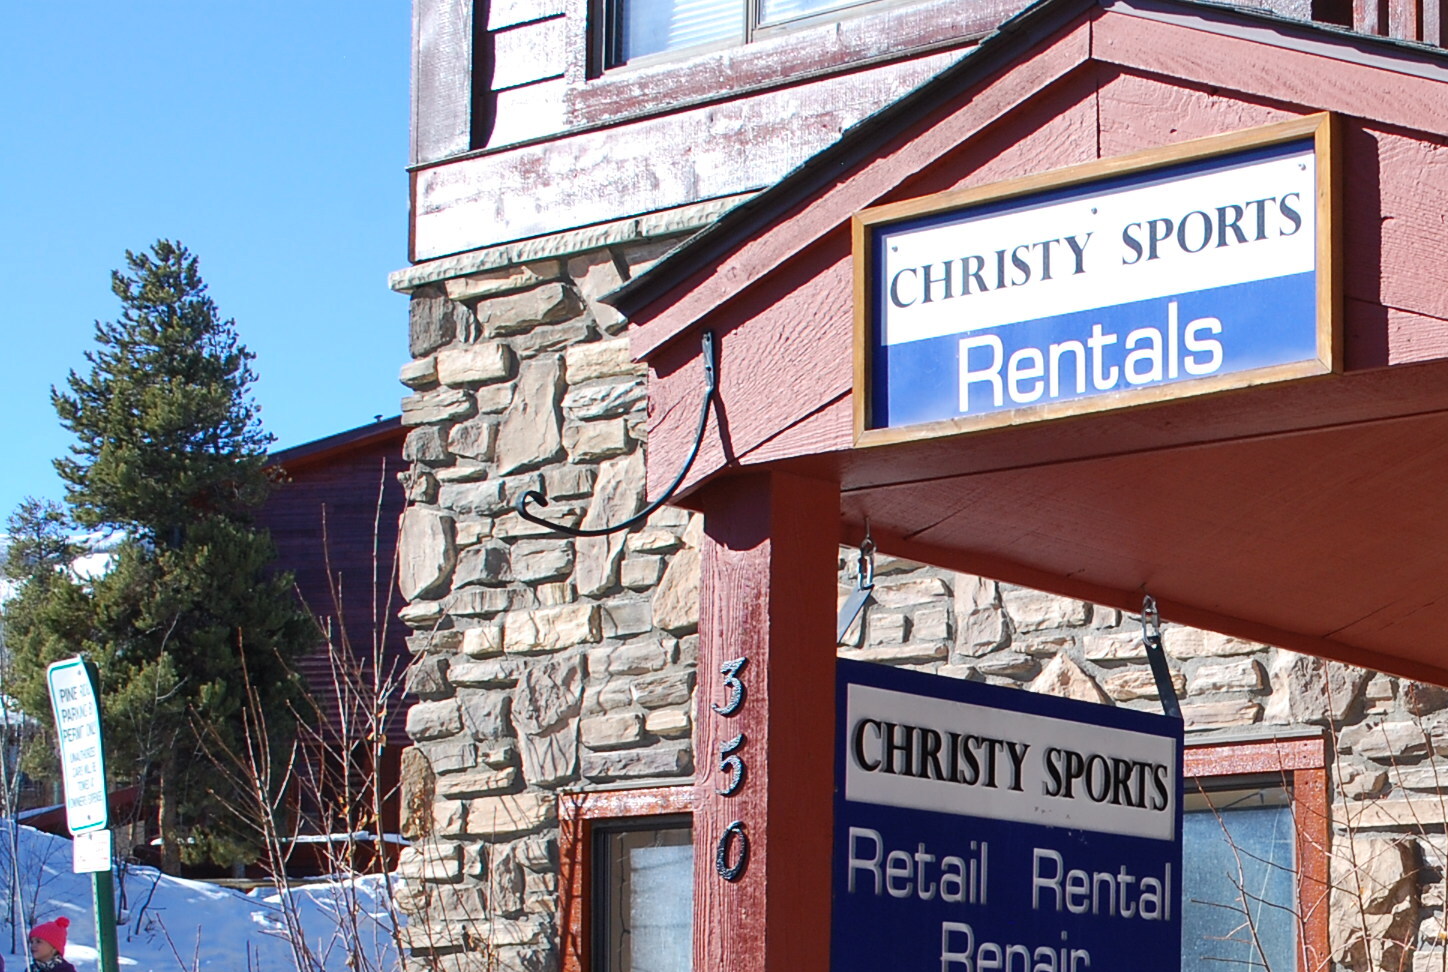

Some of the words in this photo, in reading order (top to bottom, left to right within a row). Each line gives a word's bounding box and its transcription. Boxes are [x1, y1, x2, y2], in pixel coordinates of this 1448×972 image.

[889, 230, 1095, 309] CHRISTY
[1121, 192, 1303, 266] SPORTS
[958, 302, 1224, 412] Rentals
[59, 686, 77, 703] PINE
[61, 704, 87, 723] PARKING
[63, 725, 84, 742] PERMIT
[851, 718, 1031, 792] CHRISTY
[1042, 746, 1170, 812] SPORTS
[847, 826, 988, 905] Retail
[1032, 847, 1172, 921] Rental
